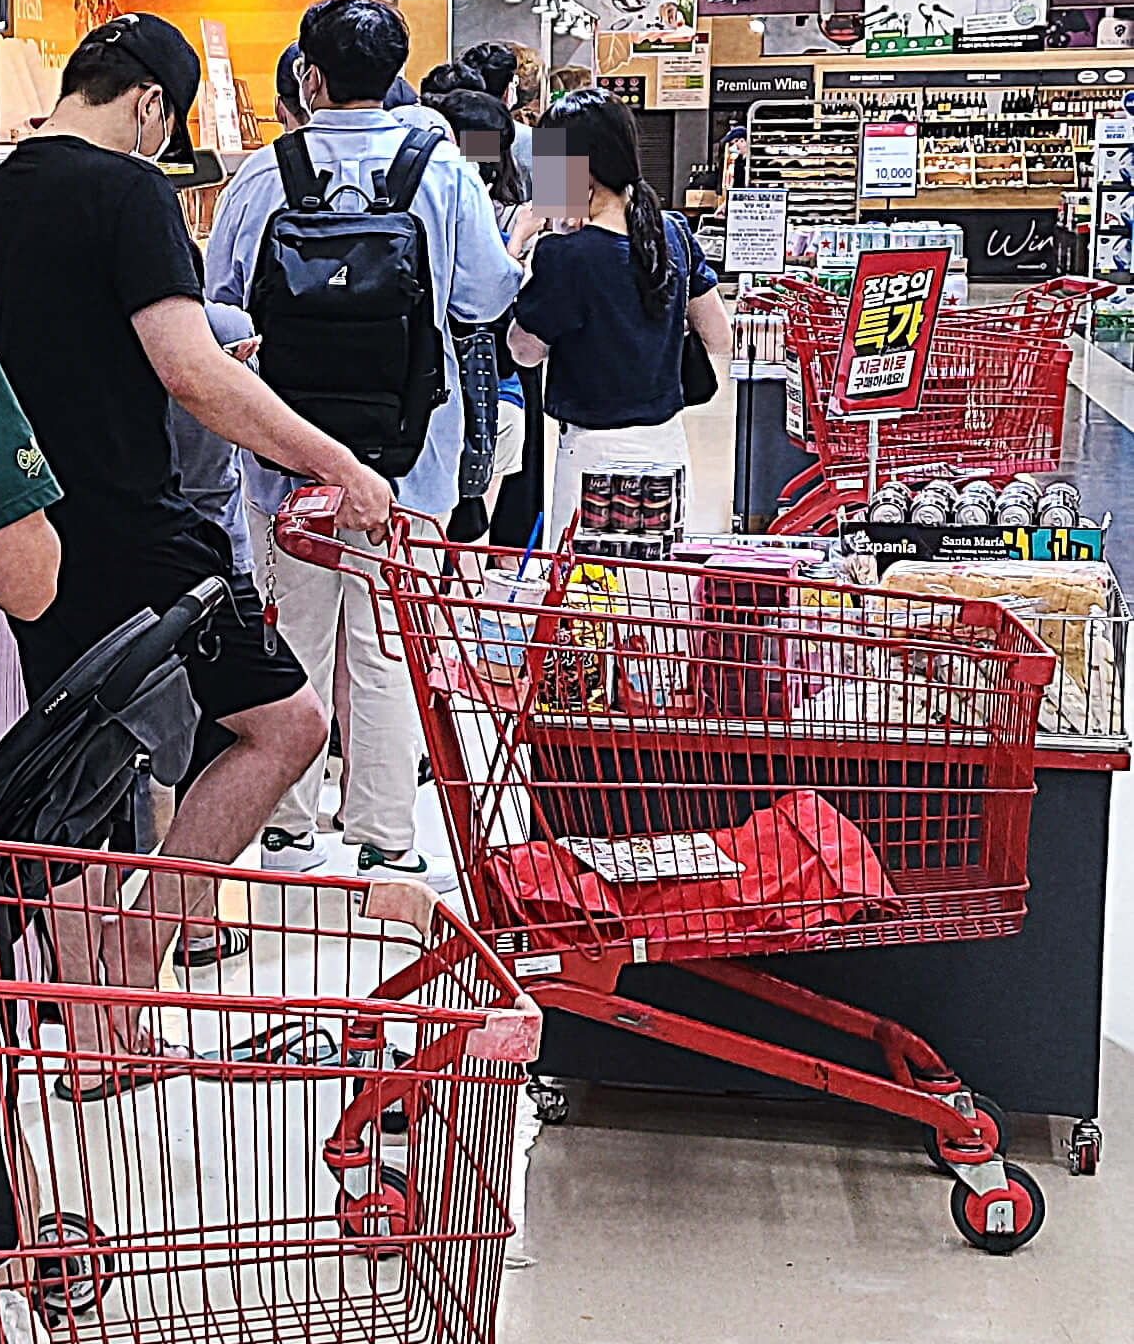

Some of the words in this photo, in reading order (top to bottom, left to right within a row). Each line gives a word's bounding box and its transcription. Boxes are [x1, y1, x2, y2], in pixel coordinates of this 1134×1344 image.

[716, 79, 771, 93] Premium
[774, 77, 809, 91] Wine
[875, 167, 913, 181] 10,000
[987, 219, 1054, 257] Win
[863, 269, 935, 308] 절호의
[854, 300, 925, 349] 특가
[857, 357, 882, 375] 지금
[882, 355, 907, 373] 바로
[853, 372, 905, 390] 구매하세요!
[942, 536, 972, 547] Santa
